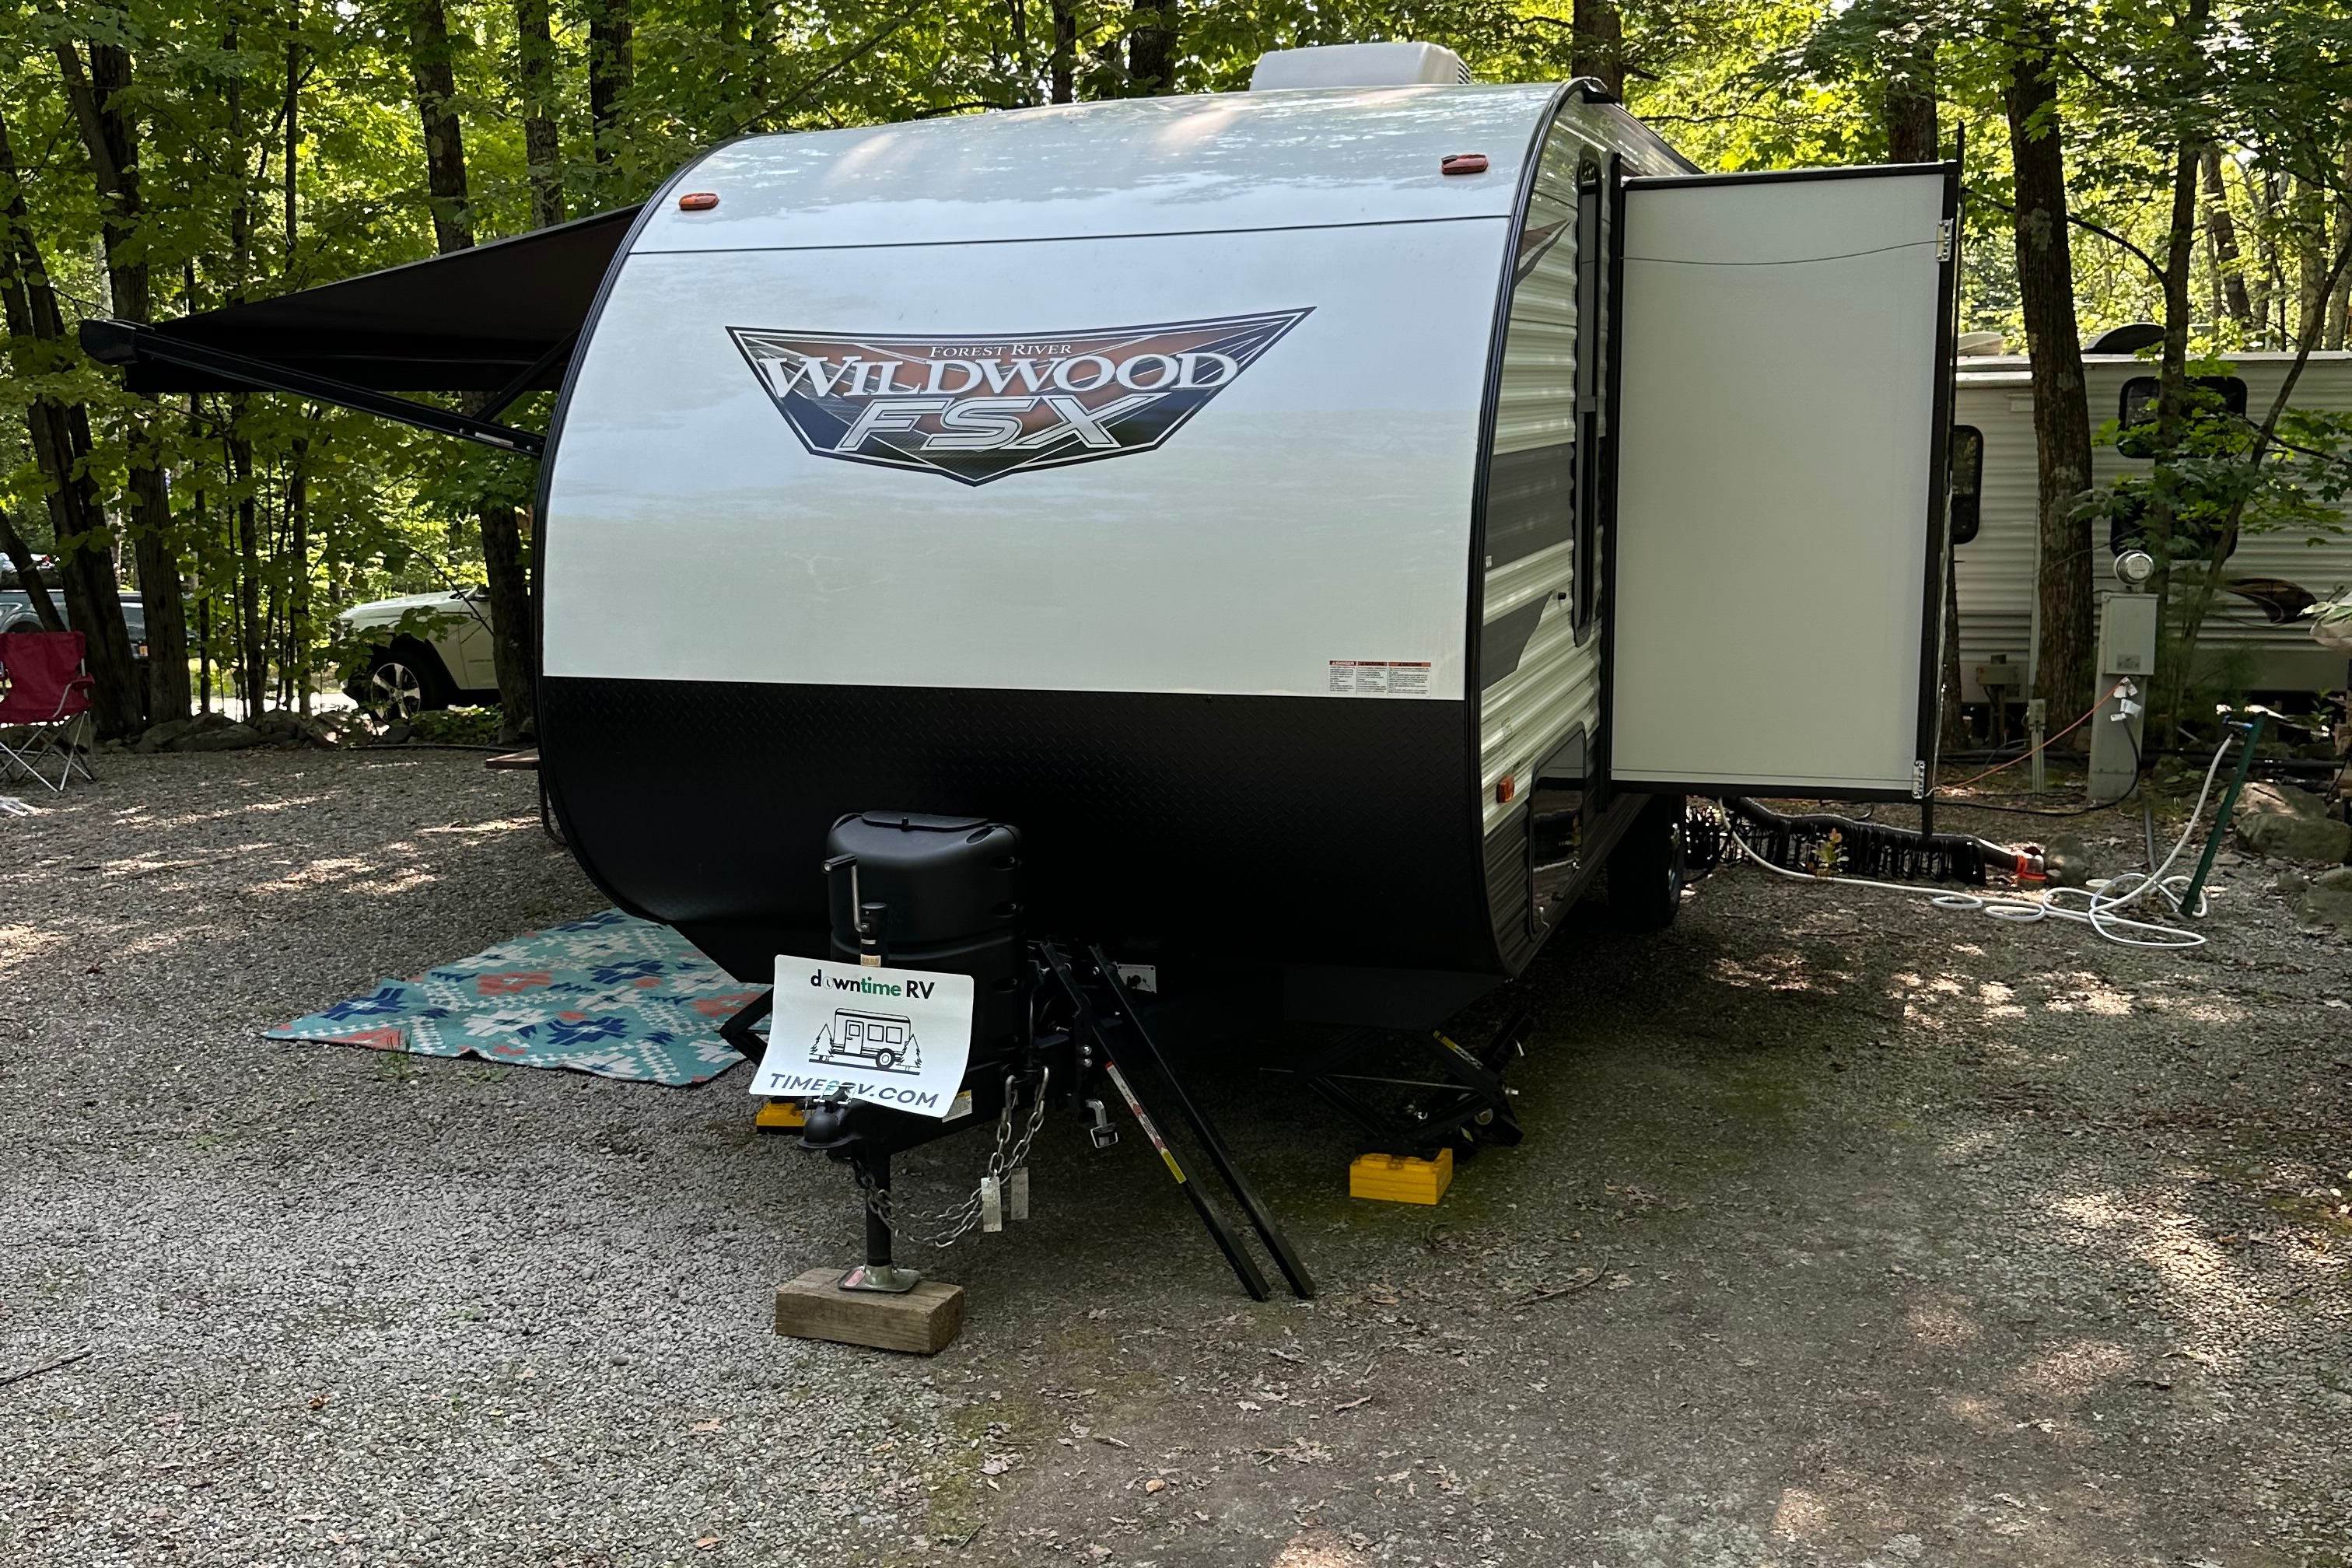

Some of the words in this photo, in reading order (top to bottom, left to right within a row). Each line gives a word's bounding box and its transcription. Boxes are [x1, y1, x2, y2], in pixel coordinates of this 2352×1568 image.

[929, 346, 1007, 358] FOREST
[1010, 344, 1072, 355] RIVER
[759, 352, 1240, 397] WILDWOOD
[834, 393, 1171, 450] FSX
[906, 979, 935, 999] RV
